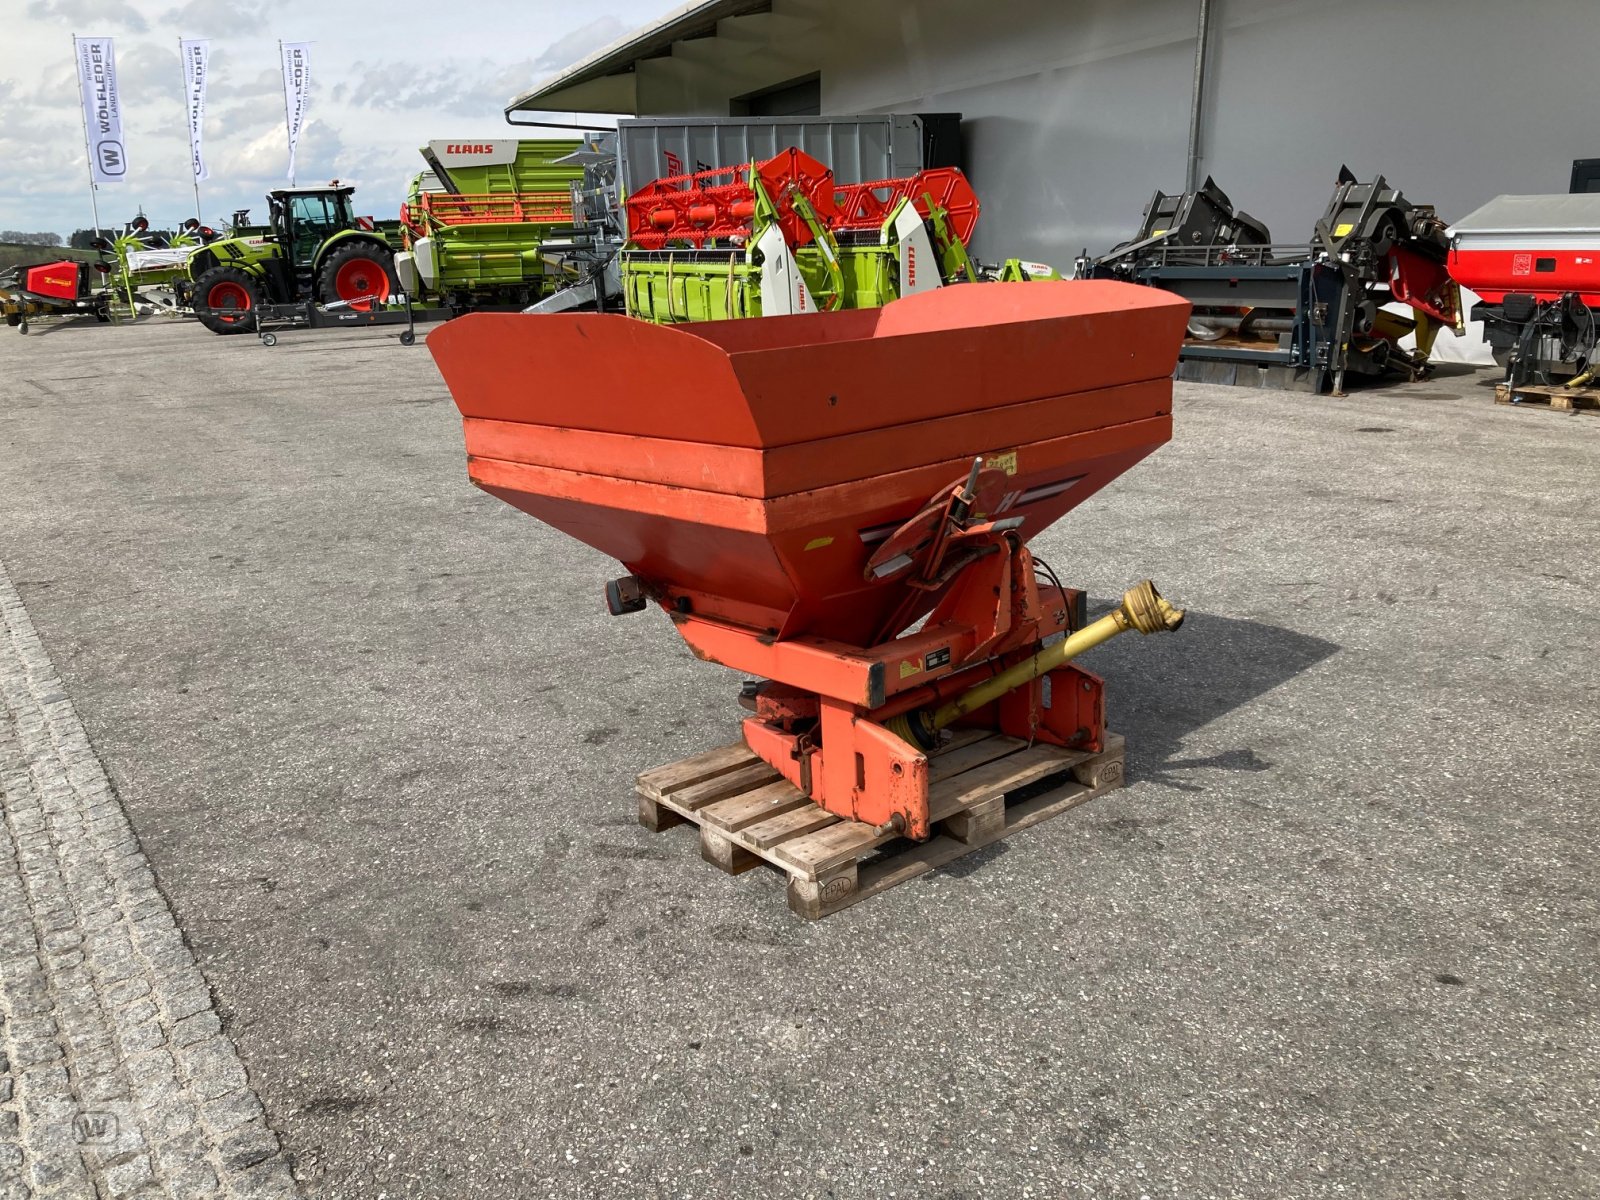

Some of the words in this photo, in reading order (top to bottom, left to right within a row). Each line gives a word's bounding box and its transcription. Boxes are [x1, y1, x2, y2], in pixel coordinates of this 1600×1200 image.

[103, 148, 121, 168] W
[446, 144, 494, 154] CLAAS
[908, 246, 916, 288] CLAAS
